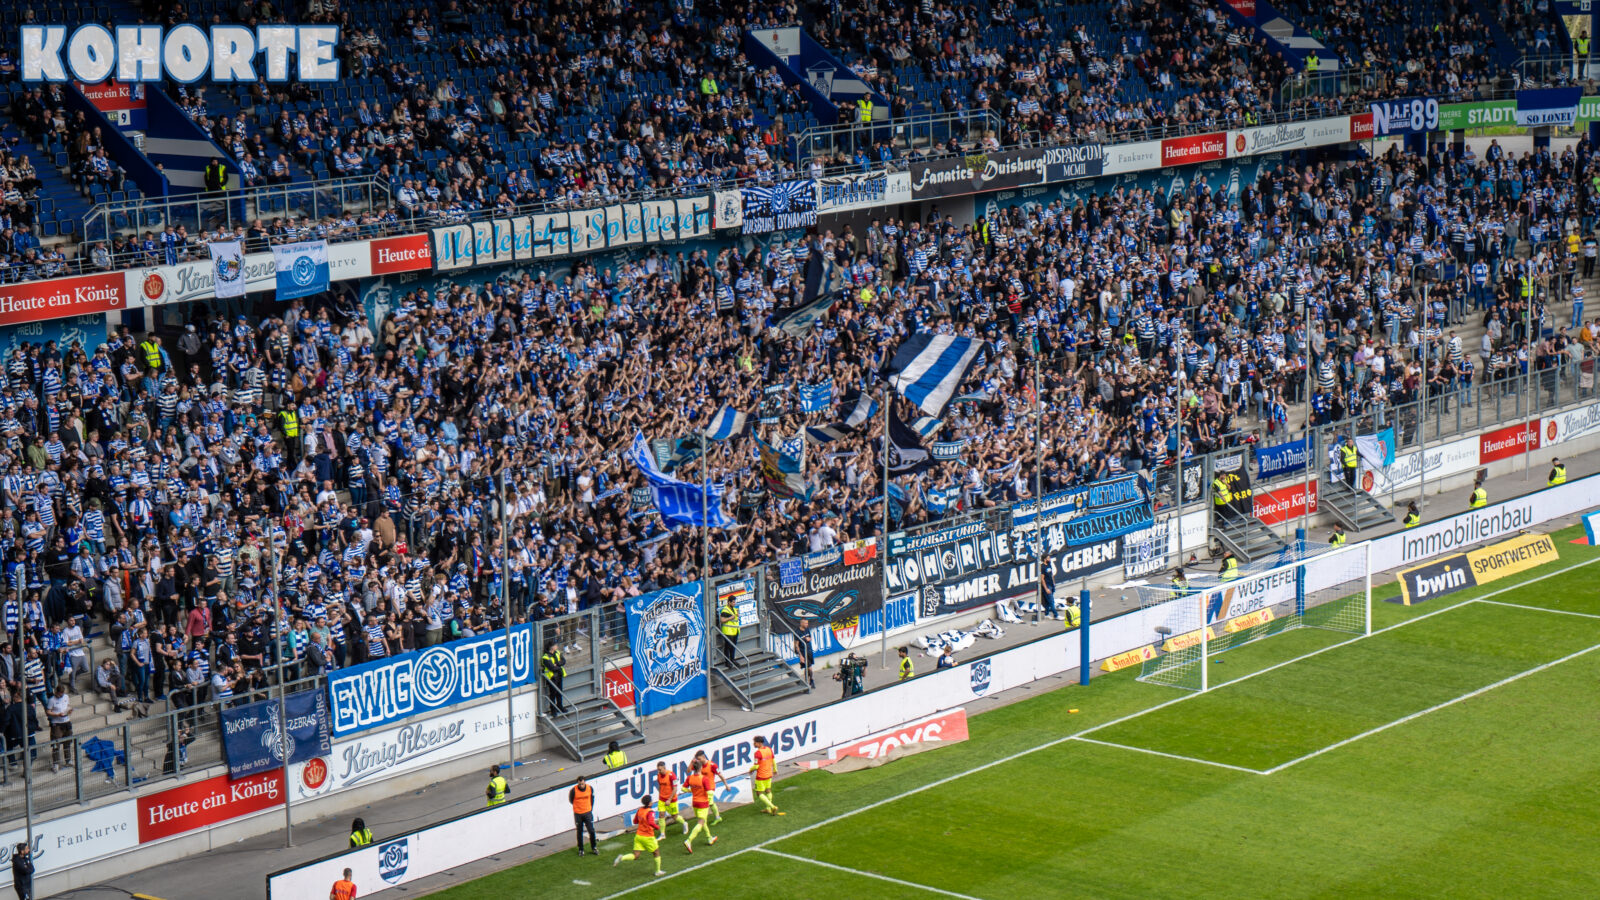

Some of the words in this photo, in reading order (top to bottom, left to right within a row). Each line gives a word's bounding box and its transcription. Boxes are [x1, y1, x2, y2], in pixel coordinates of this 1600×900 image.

[104, 89, 118, 98] ein
[121, 112, 127, 124] 9
[1354, 121, 1373, 134] Heute
[1526, 114, 1539, 125] SO
[1046, 144, 1102, 166] DISPARGUM
[1118, 151, 1154, 164] Fankurve
[1165, 144, 1188, 158] Heute
[1189, 144, 1201, 155] ein
[1201, 139, 1224, 156] König
[980, 157, 1043, 182] Duisburg
[378, 247, 416, 264] Heute
[175, 266, 215, 296] Köni
[1, 295, 47, 314] Heute
[48, 290, 71, 309] ein
[74, 284, 119, 306] König
[1484, 438, 1505, 455] Heute
[1504, 436, 1516, 448] ein
[1252, 504, 1277, 518] Heute
[1402, 504, 1533, 561] Immobilienbau
[1473, 537, 1553, 574] SPORTWETTEN
[810, 564, 875, 593] Generation
[944, 573, 1002, 605] IMMER
[1008, 558, 1058, 590] ALLS
[1061, 540, 1118, 574] GEBEN!
[1415, 564, 1467, 598] bwin
[1229, 595, 1265, 618] GRUPPE
[1234, 614, 1261, 630] Sinalco
[1172, 633, 1200, 650] Sinalco
[1111, 653, 1141, 670] Sinalco
[331, 659, 415, 732] EWIG
[455, 628, 530, 698] TREU
[605, 679, 635, 699] Heu
[315, 694, 331, 751] DUISBURG
[773, 720, 818, 755] MSV!
[340, 739, 398, 780] König
[393, 718, 466, 766] Pilsener
[253, 757, 270, 770] MSV
[148, 800, 199, 827] Heute
[201, 792, 227, 811] ein
[230, 776, 279, 805] König
[56, 821, 128, 850] Fankurve
